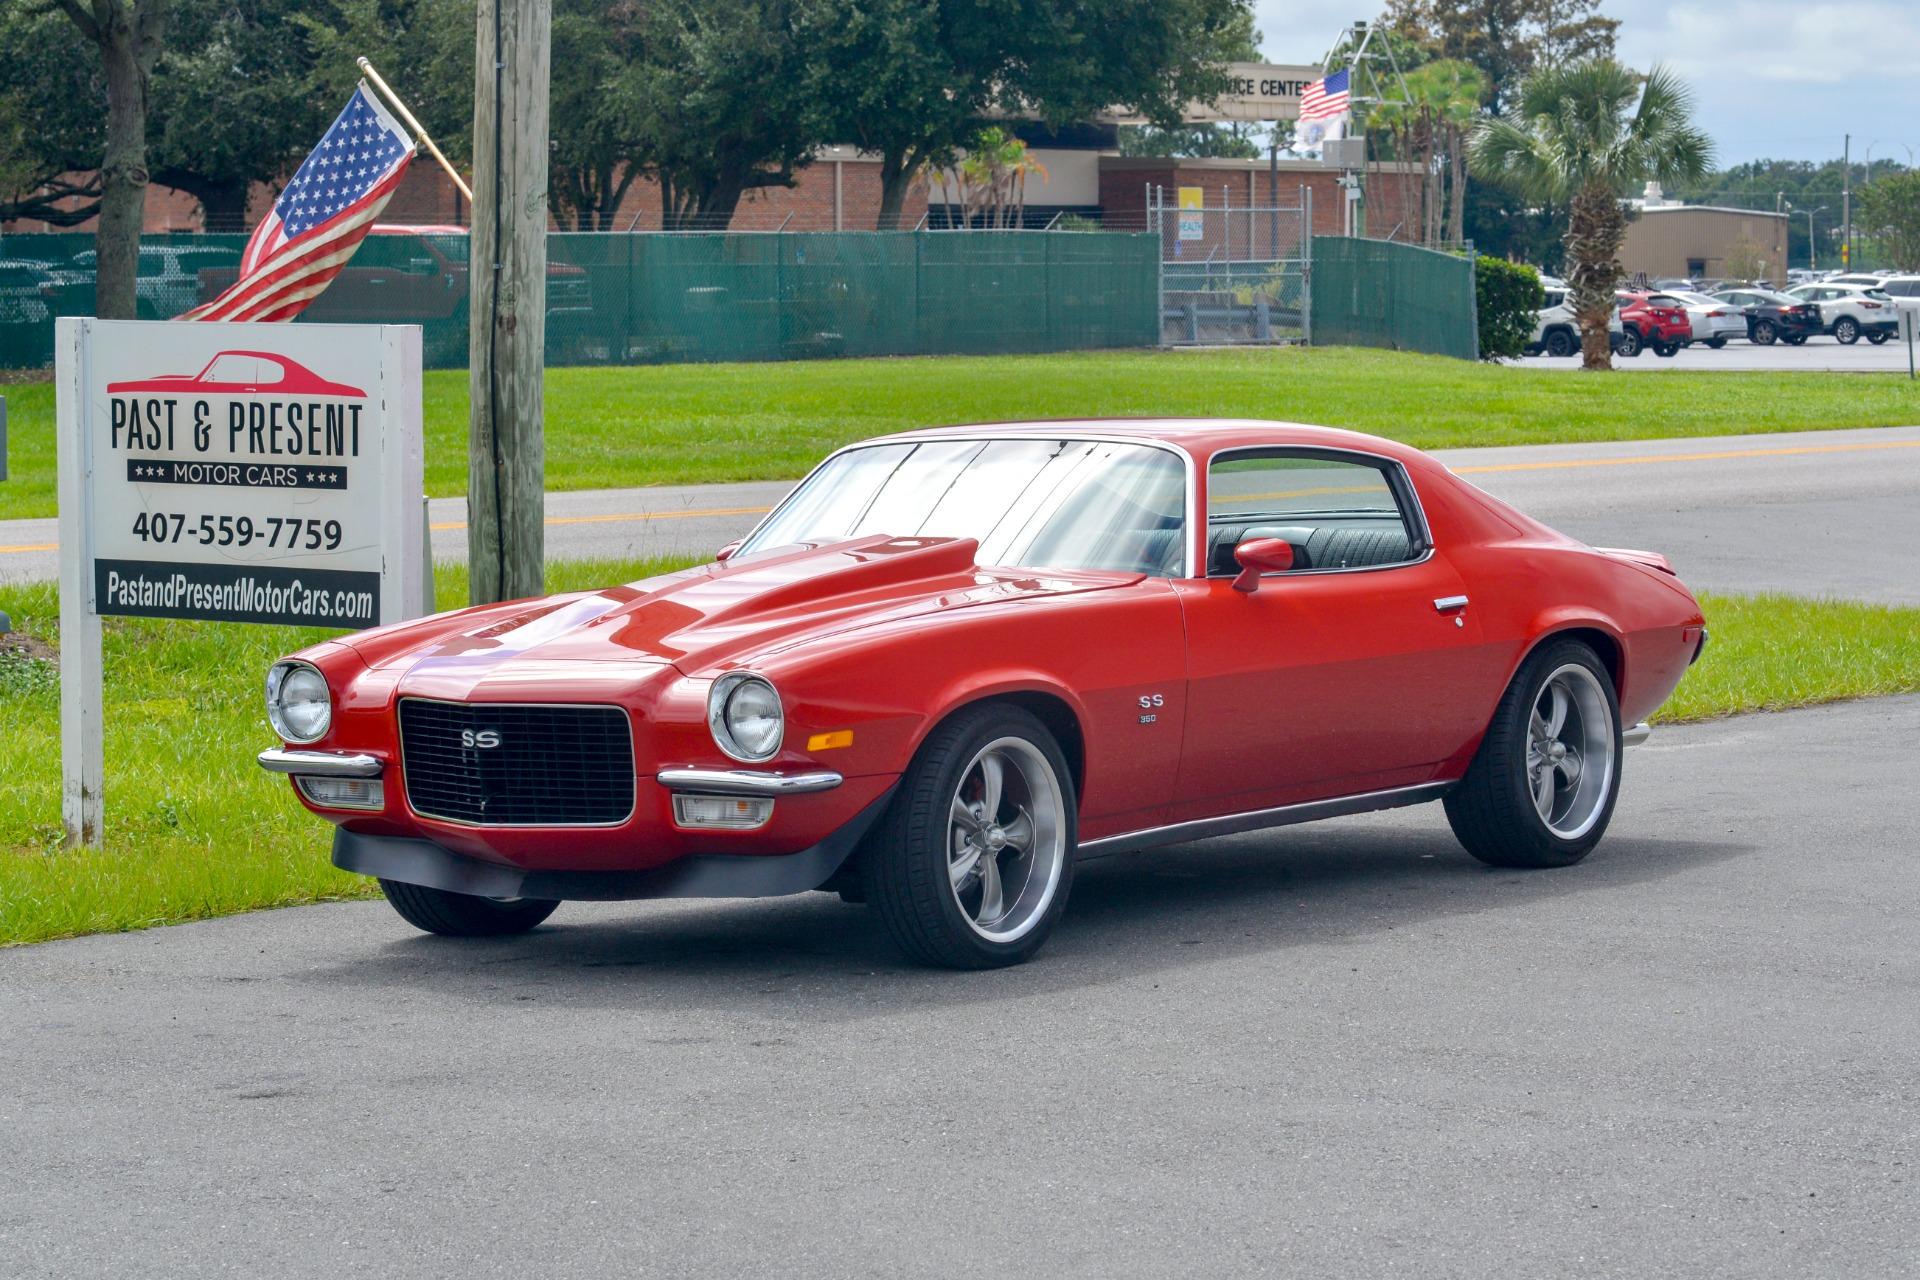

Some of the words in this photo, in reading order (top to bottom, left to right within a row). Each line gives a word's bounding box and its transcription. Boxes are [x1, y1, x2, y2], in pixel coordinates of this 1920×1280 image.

[111, 398, 177, 451] PAST
[194, 401, 212, 452] &
[229, 401, 363, 457] PRESENT
[173, 463, 240, 484] MOTOR
[246, 466, 298, 486] CARS
[132, 512, 342, 550] 407-559-7759
[107, 571, 372, 619] PastandPresentMotorCars.com
[1139, 694, 1164, 708] SS
[461, 729, 500, 748] SS
